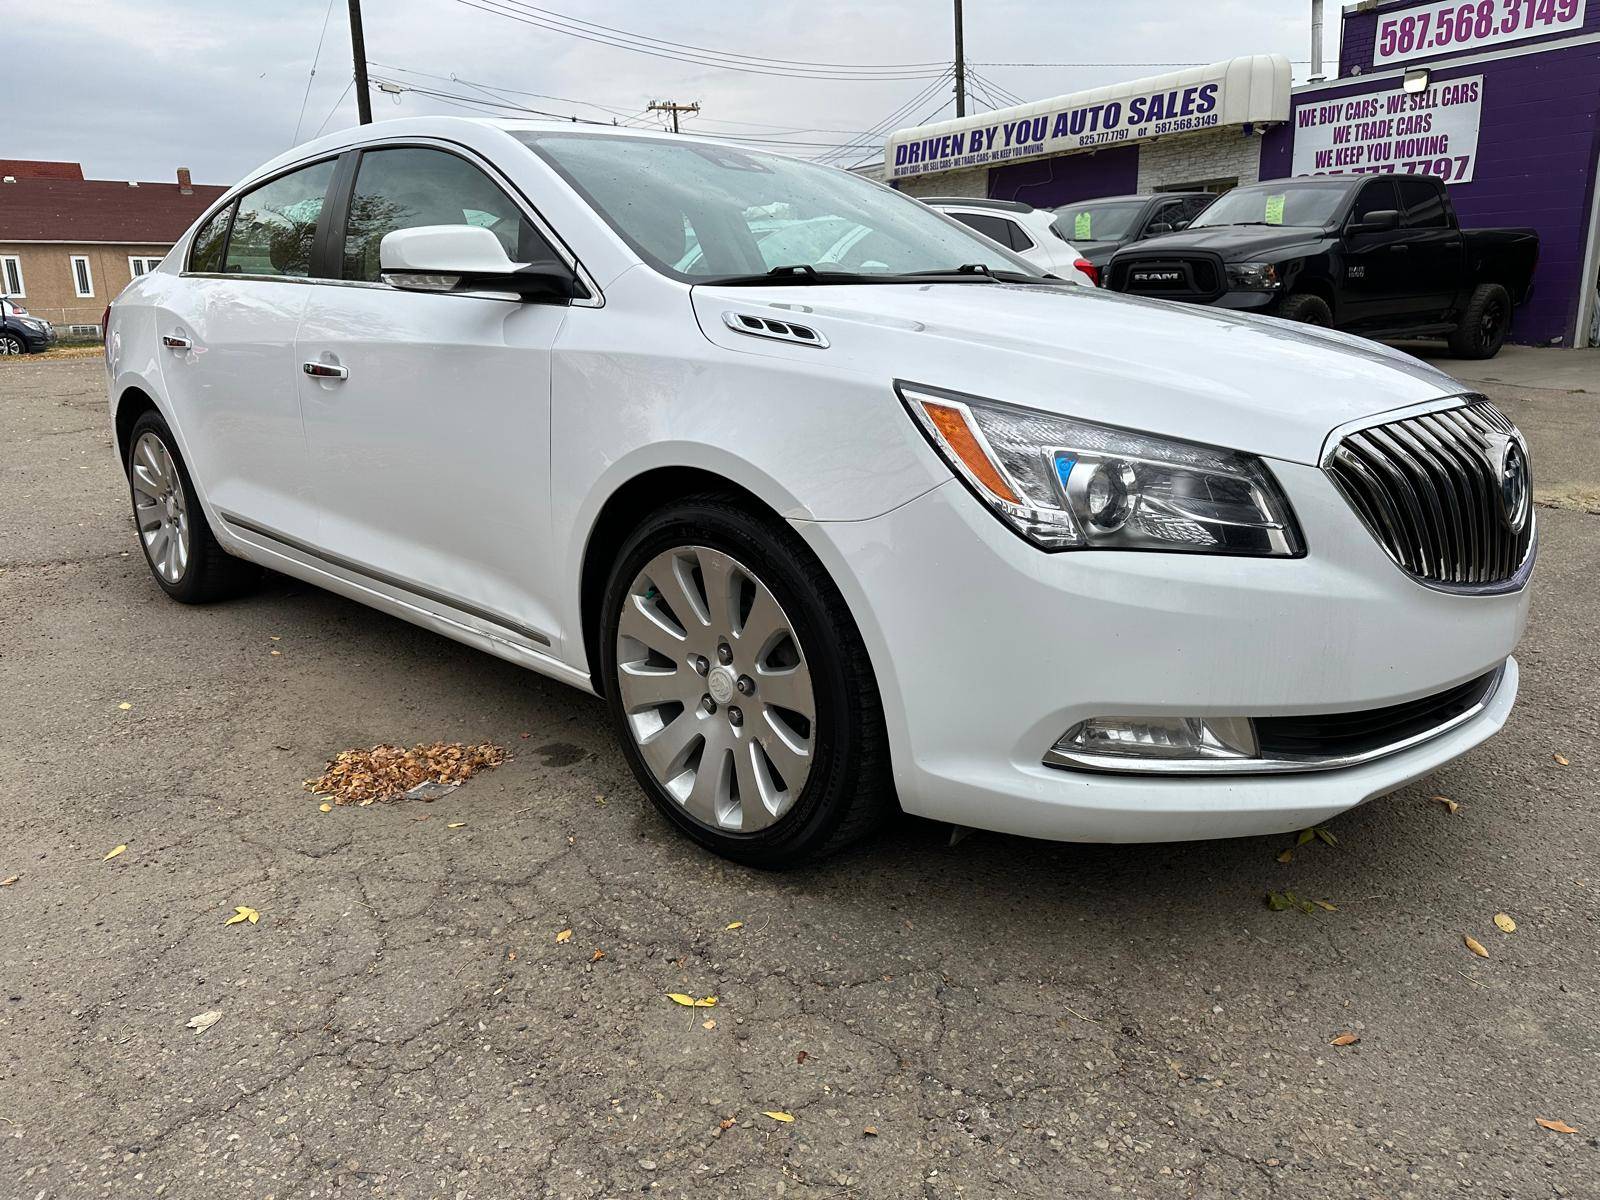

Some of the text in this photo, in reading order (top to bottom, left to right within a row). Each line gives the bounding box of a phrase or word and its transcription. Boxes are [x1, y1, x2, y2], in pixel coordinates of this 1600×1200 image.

[1379, 0, 1579, 57] 587.568.3149
[1299, 82, 1479, 128] WE BUY CARS WE SELL CARS
[895, 84, 1219, 166] DRIVEN BY YOU AUTO SALES
[1080, 114, 1218, 146] 825.777.7797 or 587.568.3149
[1333, 114, 1433, 145] WE TRADE CARS
[894, 144, 1044, 177] WE BUY CARS WE SELL CARS WE TRADE CARS WE KEEP YOU MOVING
[1316, 150, 1333, 169] WE
[1336, 147, 1364, 167] KEEP
[1367, 142, 1393, 162] YOU
[1395, 135, 1449, 160] MOVING
